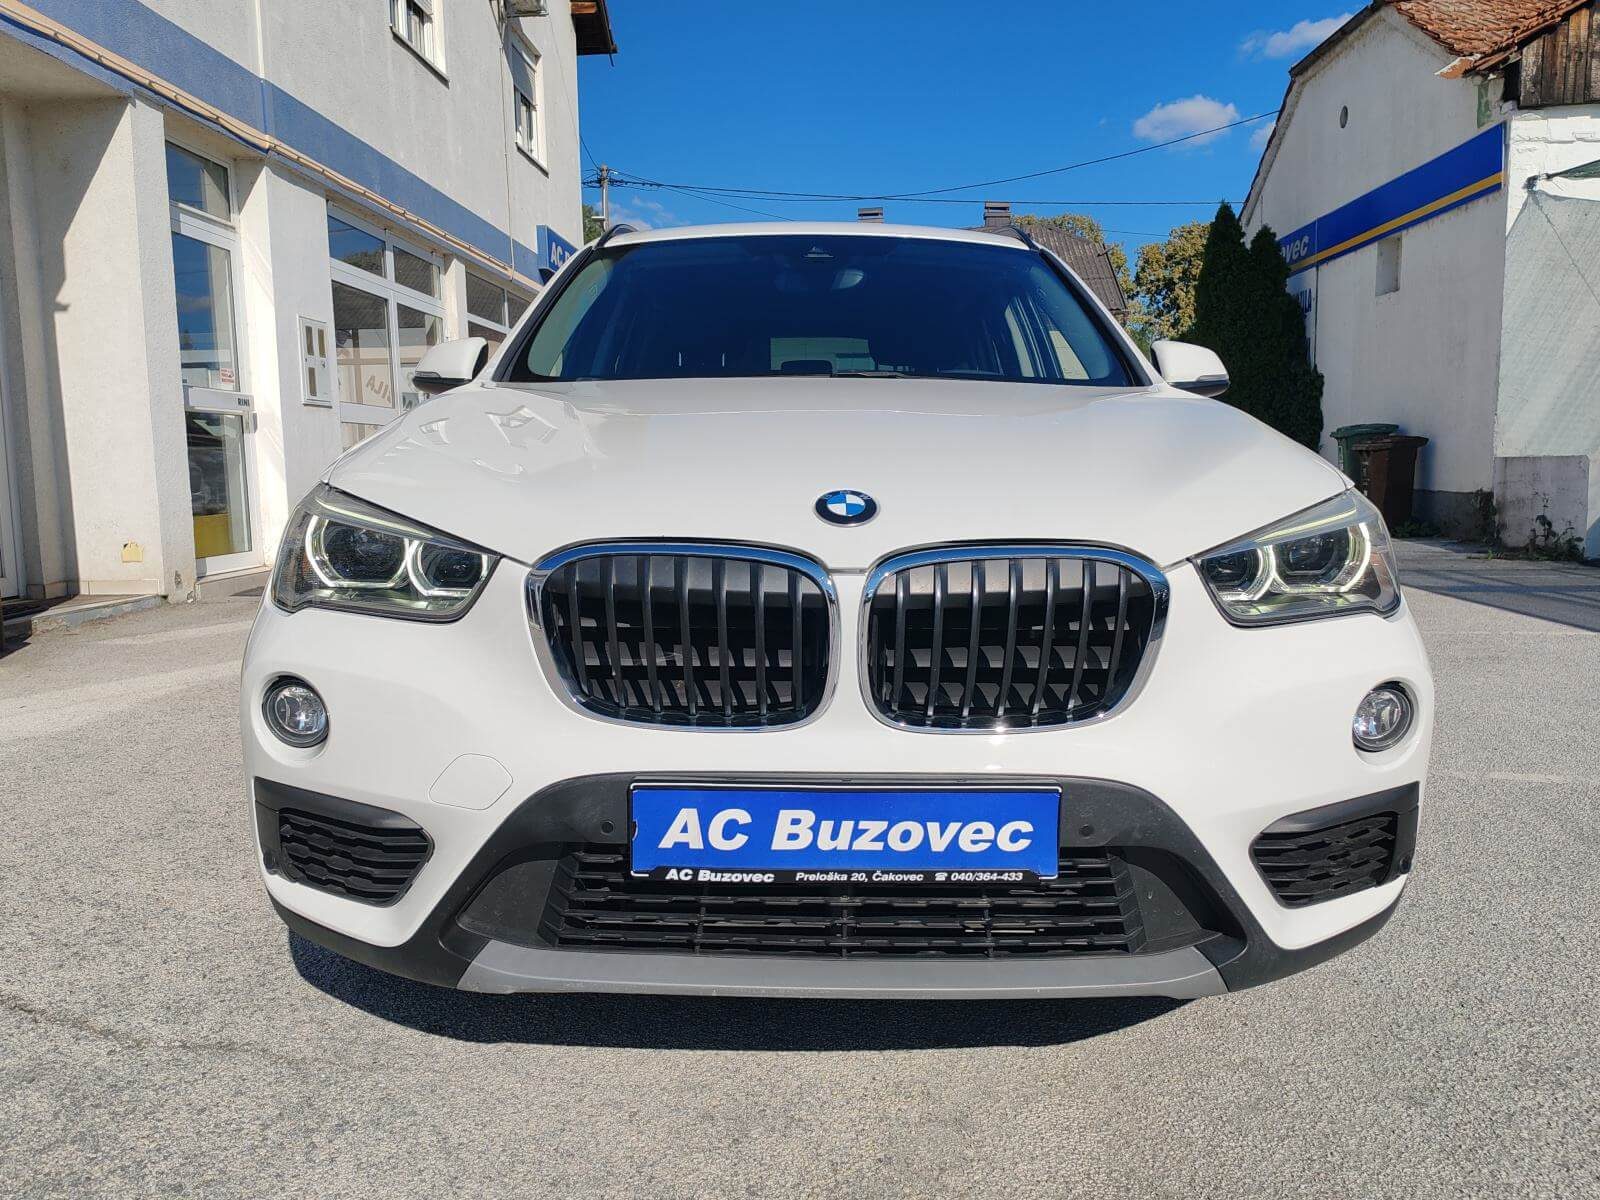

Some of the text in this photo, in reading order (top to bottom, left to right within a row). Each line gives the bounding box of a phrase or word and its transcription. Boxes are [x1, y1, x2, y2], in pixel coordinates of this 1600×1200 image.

[658, 807, 1033, 852] AC Buzovec
[665, 868, 1023, 882] AC Buzovec Preloška 20, Čakovec 040/364-433
